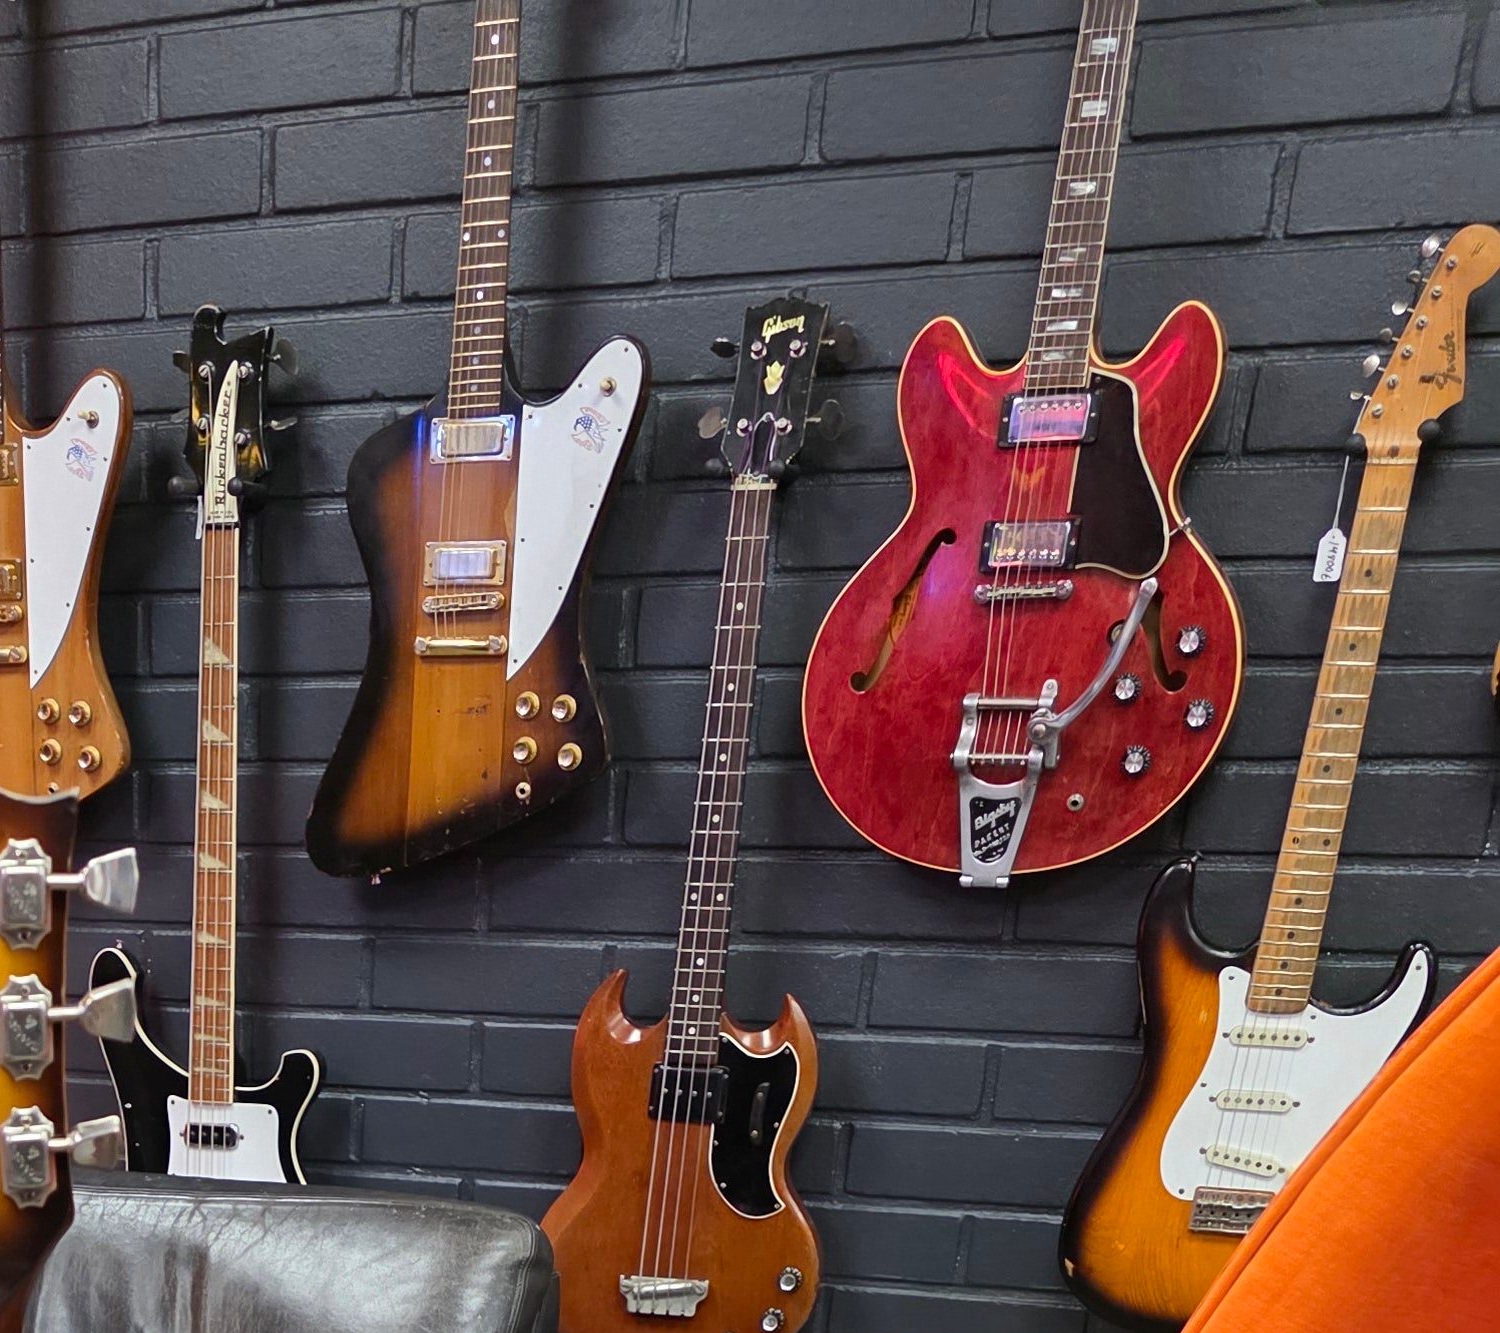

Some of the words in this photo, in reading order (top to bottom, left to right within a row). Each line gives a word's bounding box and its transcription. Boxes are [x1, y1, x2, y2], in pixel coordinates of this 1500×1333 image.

[762, 315, 805, 343] Gibson
[1438, 330, 1462, 390] Fender
[215, 389, 232, 506] Rickenbacker
[975, 800, 1016, 831] Bigsby
